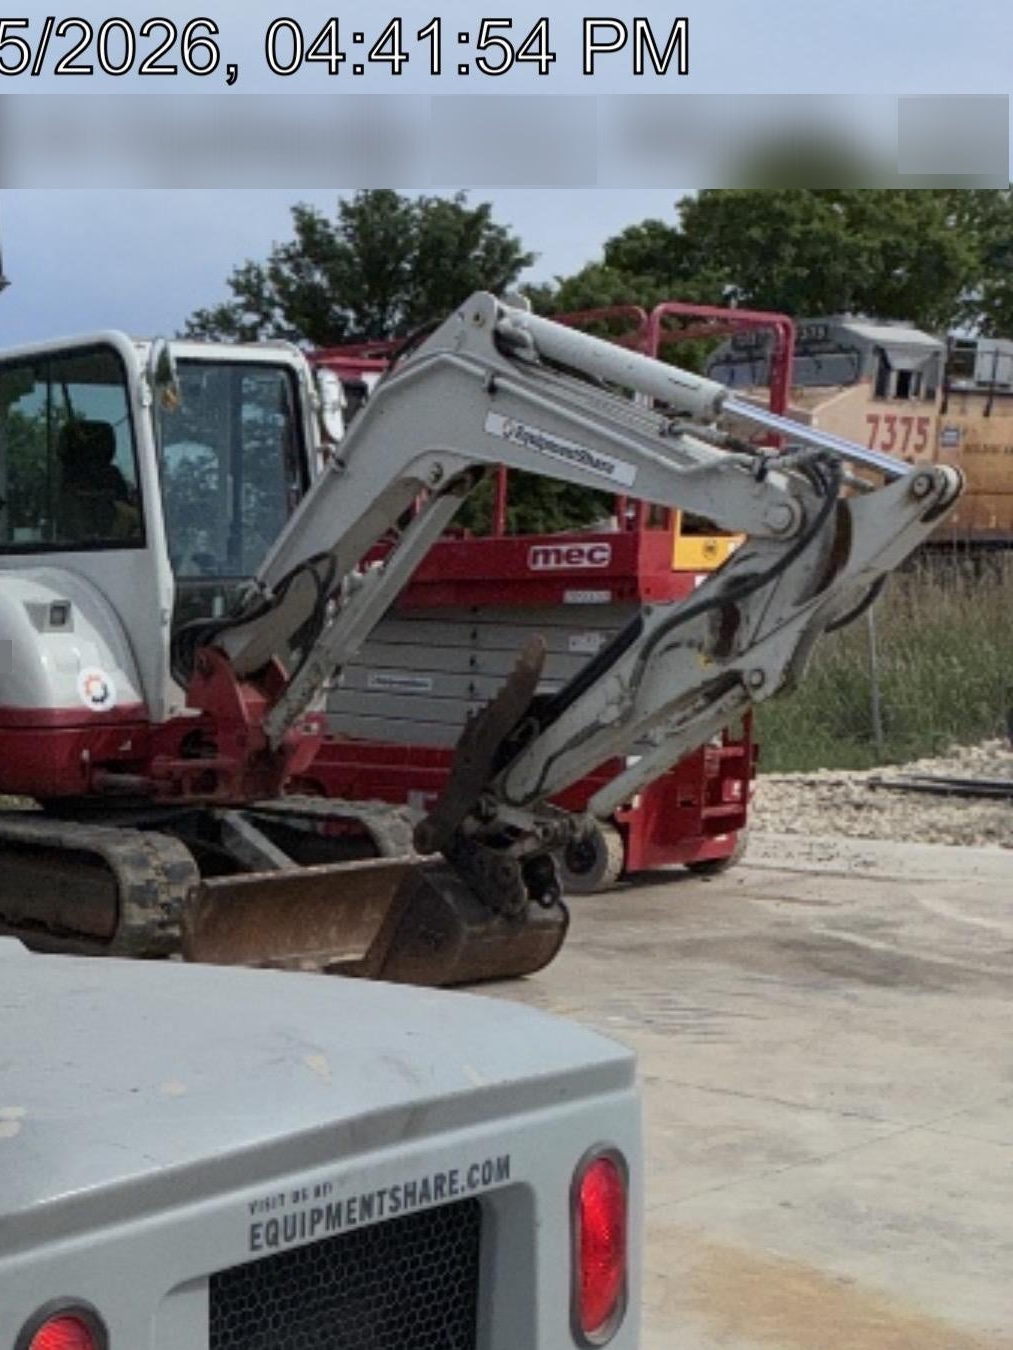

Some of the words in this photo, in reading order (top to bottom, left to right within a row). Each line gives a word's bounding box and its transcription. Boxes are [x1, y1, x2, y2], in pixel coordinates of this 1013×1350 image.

[866, 413, 930, 453] 7375
[531, 546, 609, 565] mec
[249, 1154, 511, 1251] EQUIPMENTSHARE.COM
